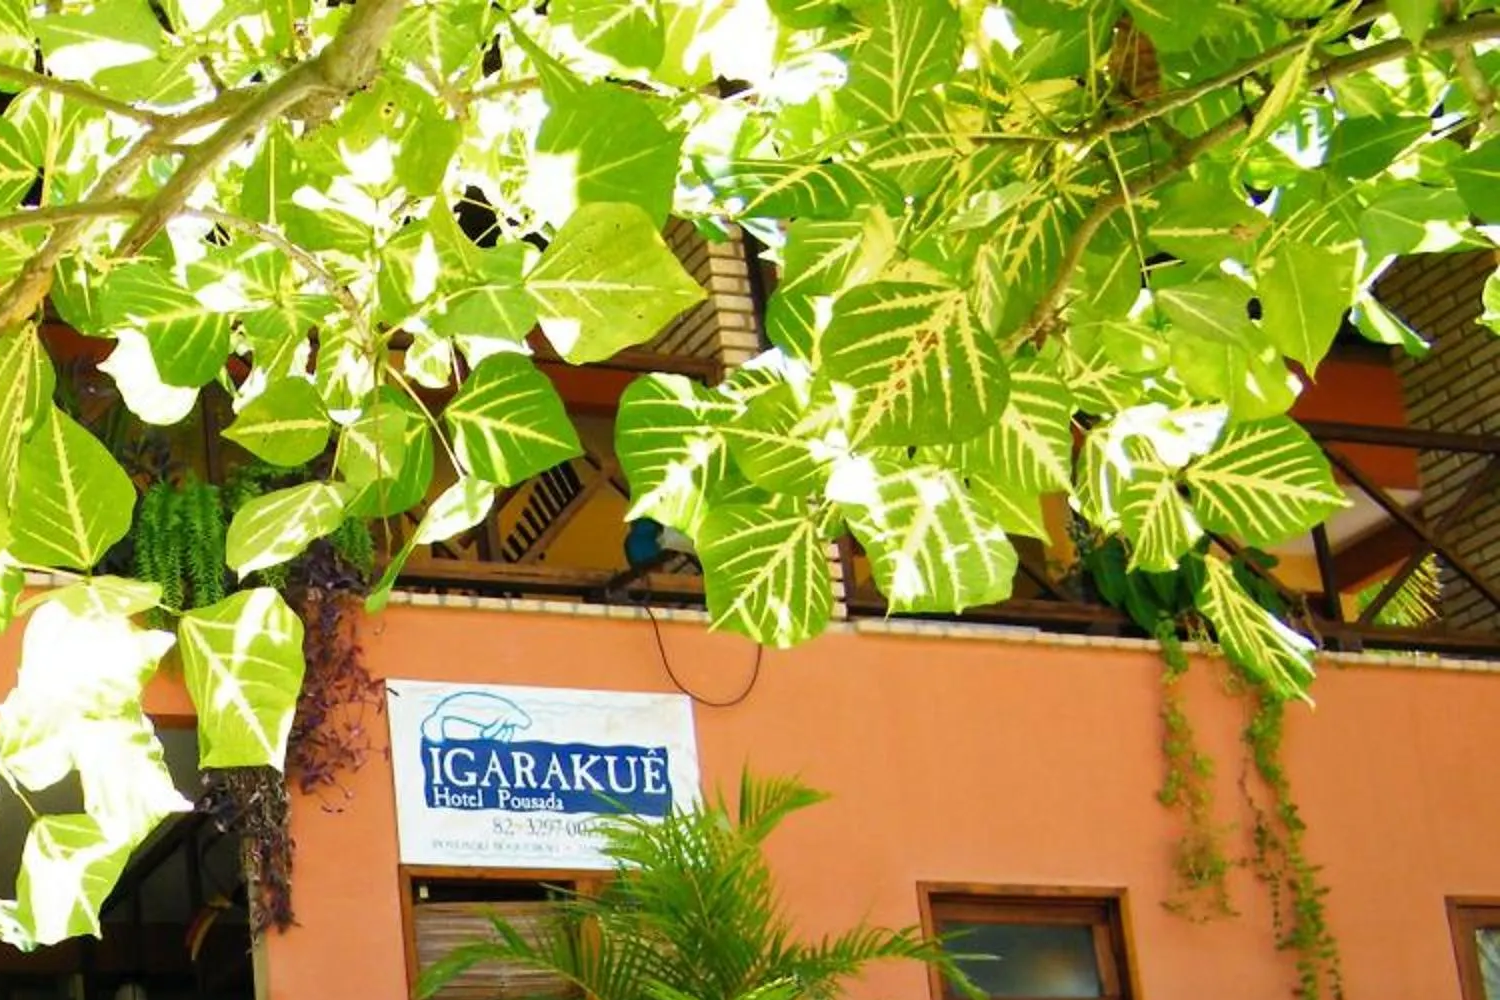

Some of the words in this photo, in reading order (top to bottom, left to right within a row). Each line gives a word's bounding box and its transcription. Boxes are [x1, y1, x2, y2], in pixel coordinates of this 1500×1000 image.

[428, 747, 667, 795] IGARAKUÊ
[432, 785, 483, 808] Hotel
[497, 789, 564, 811] Pousada
